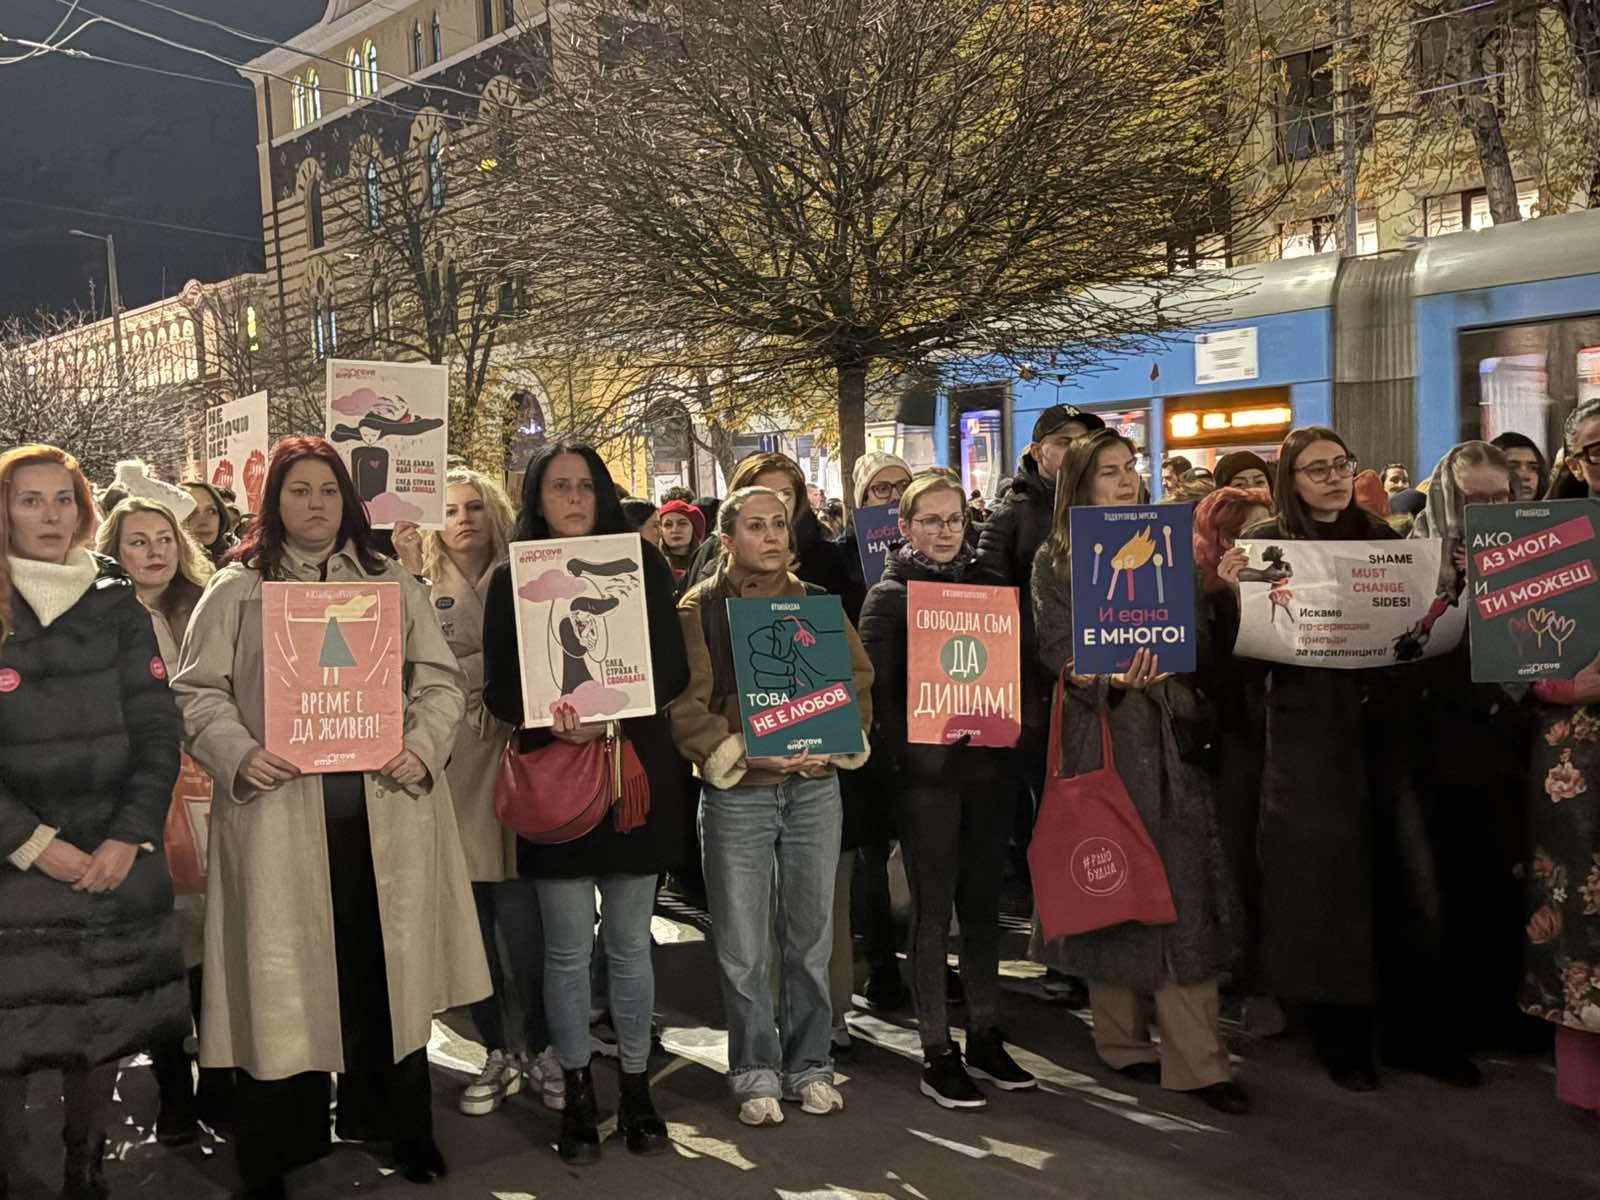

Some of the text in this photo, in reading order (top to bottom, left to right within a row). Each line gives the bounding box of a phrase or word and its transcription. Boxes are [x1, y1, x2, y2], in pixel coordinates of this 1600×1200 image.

[208, 407, 223, 426] НЕ
[208, 415, 249, 442] ЗНАЧИ
[208, 438, 228, 460] НЕ!
[1472, 532, 1513, 549] АКО
[1368, 554, 1413, 565] SHAME
[1482, 532, 1562, 572] АЗ МОГА
[1351, 568, 1387, 579] MUST
[1352, 582, 1405, 594] CHANGE
[1475, 581, 1489, 596] И
[1480, 565, 1592, 614] ТИ МОЖЕШ
[1372, 597, 1412, 608] SIDES!
[916, 609, 1013, 636] СВОБОДНА СЪМ
[1098, 607, 1169, 627] И една
[1299, 608, 1343, 618] Искаме
[1083, 626, 1186, 646] Е МНОГО!
[949, 639, 980, 678] ДА
[301, 690, 364, 715] ВРЕМЕ Е
[746, 692, 791, 708] ТОВА
[752, 687, 848, 733] НЕ Е ЛЮБОВ
[913, 682, 1015, 720] ДИШАМ!
[289, 713, 380, 745] ДА ЖИВЕЯ!
